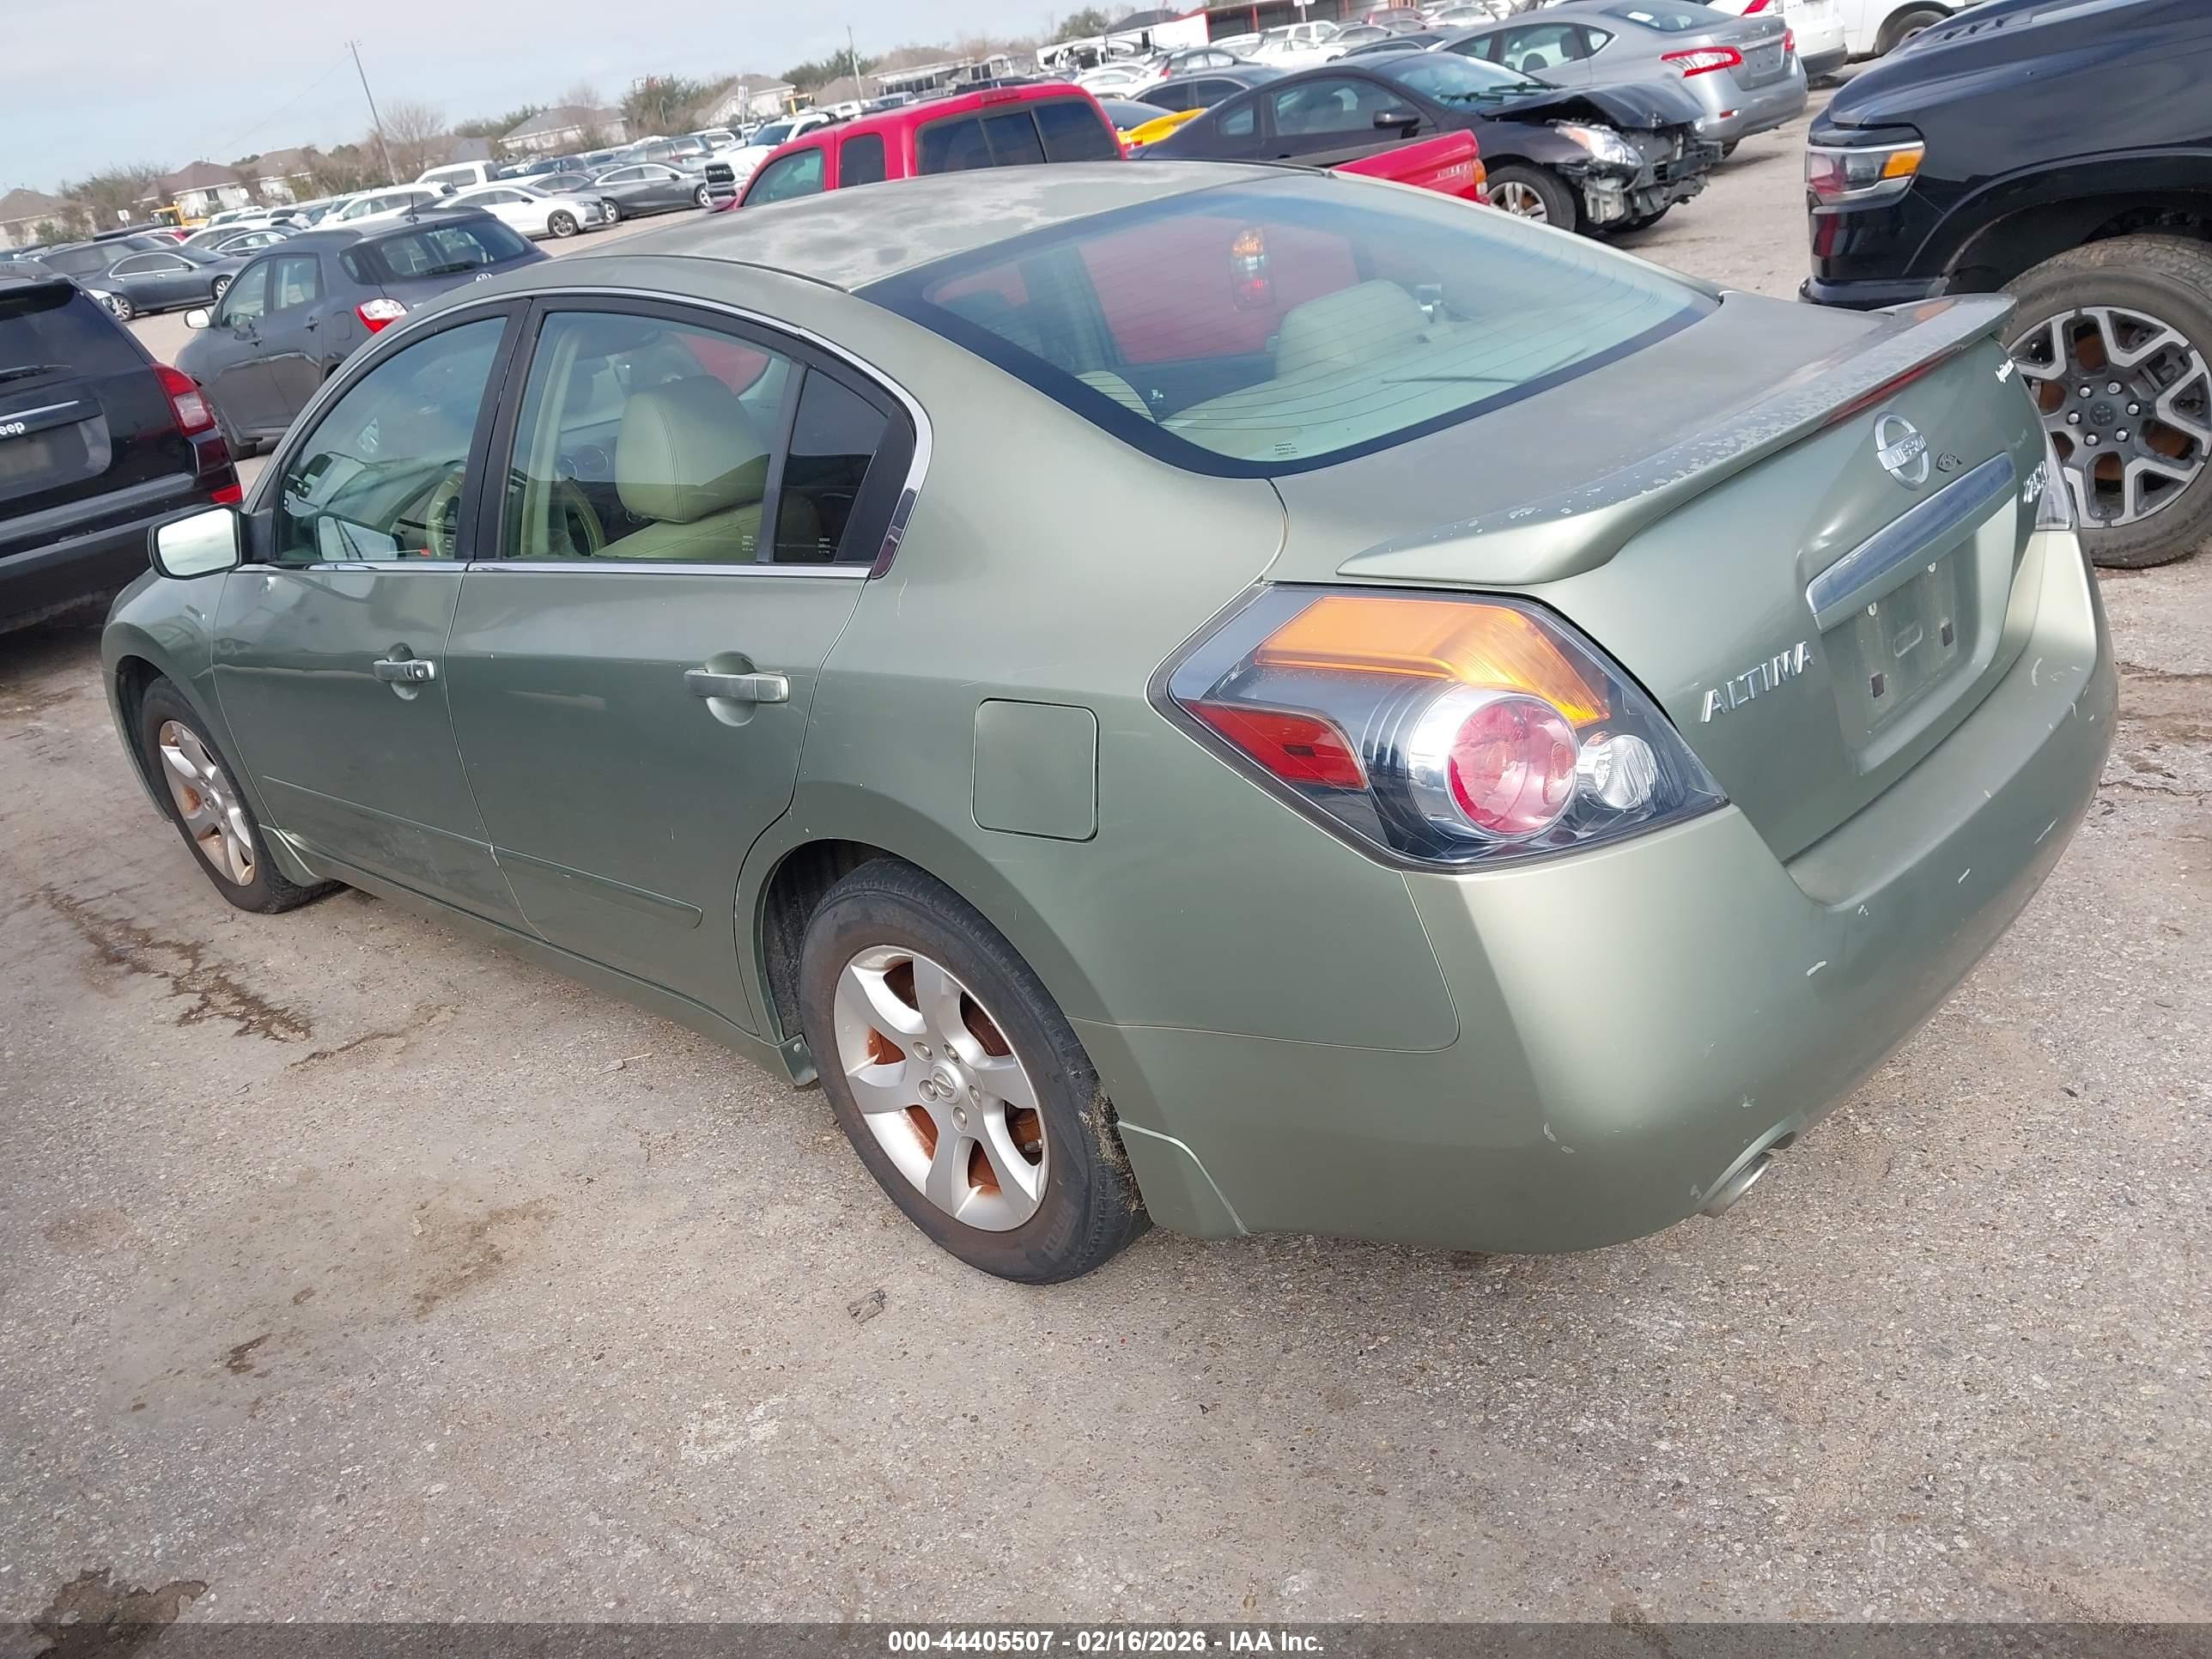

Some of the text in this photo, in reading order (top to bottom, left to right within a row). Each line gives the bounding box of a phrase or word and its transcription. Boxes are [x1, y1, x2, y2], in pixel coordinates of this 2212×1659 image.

[0, 422, 25, 435] eep
[1890, 434, 1927, 464] NISSAN
[1700, 640, 1814, 723] ALTIMA
